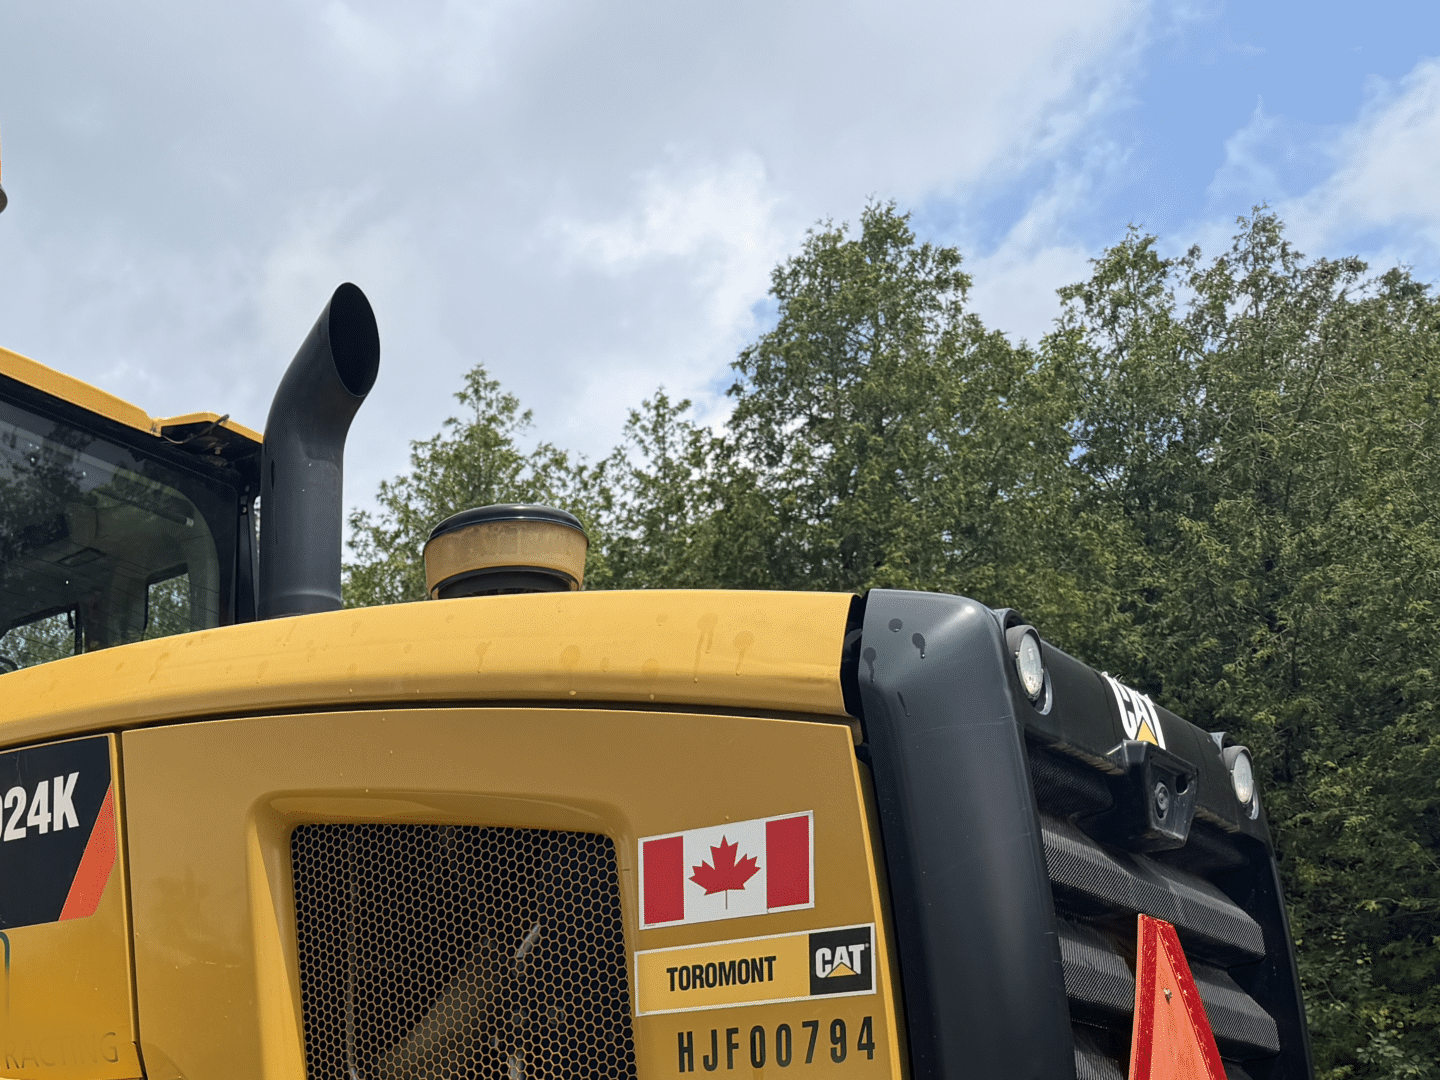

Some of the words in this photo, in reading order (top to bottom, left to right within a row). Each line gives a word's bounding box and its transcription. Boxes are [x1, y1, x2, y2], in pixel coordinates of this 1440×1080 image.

[1101, 671, 1166, 750] CAT
[666, 955, 777, 992] TOROMONT
[815, 943, 866, 979] CAT
[677, 1015, 876, 1073] HJF00794
